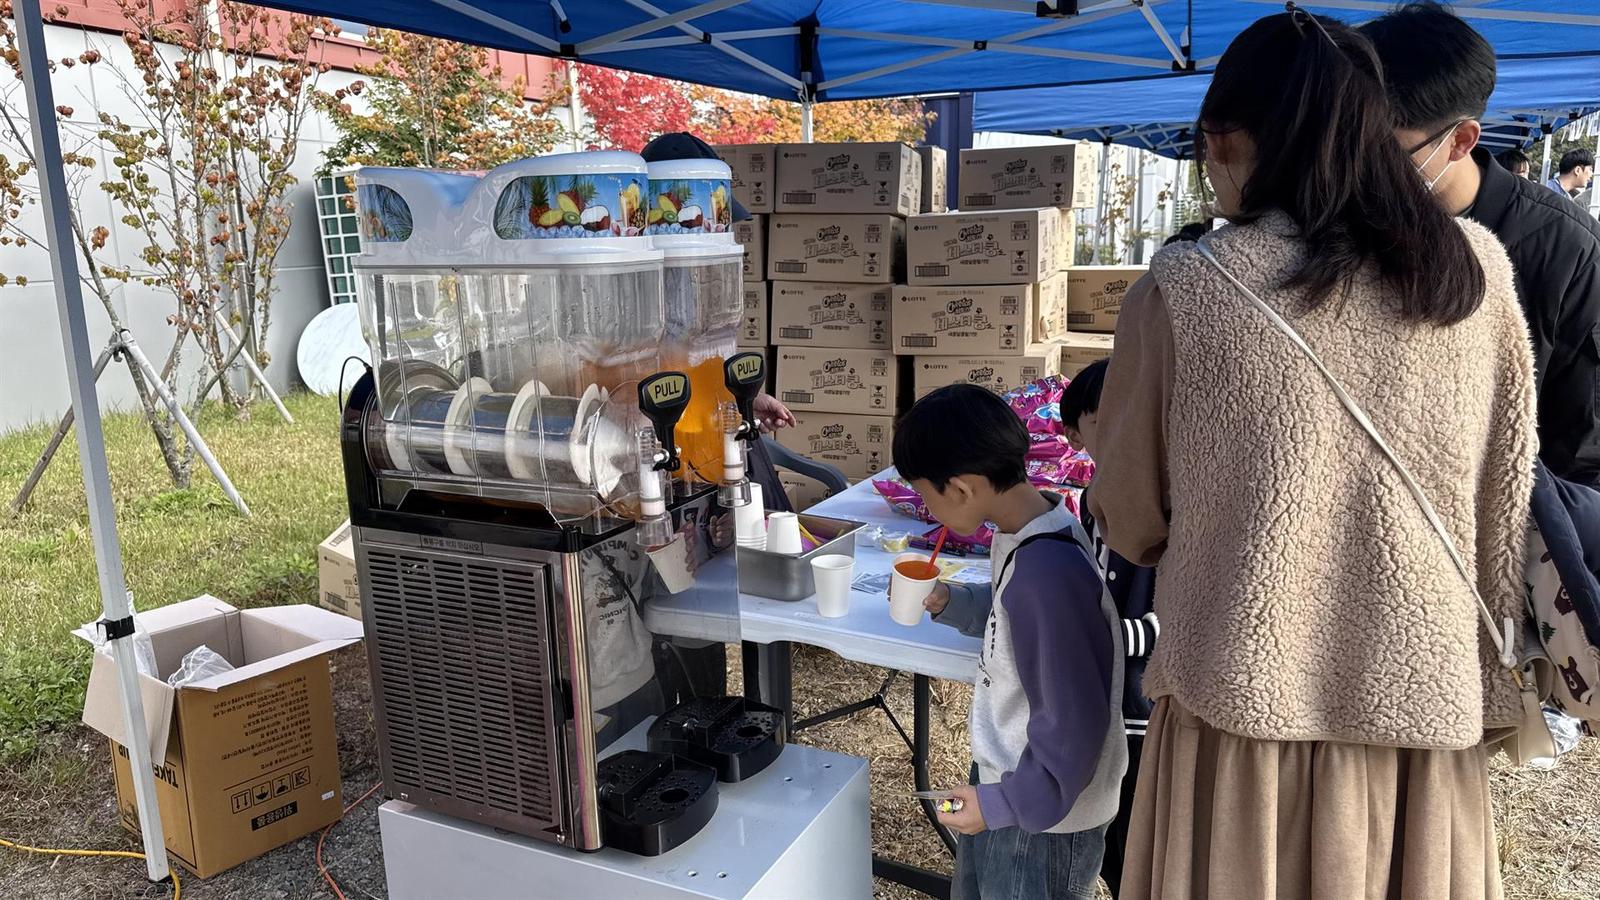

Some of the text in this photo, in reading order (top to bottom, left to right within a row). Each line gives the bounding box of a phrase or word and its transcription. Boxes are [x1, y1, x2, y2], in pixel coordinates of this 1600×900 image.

[737, 360, 758, 376] PULL
[654, 380, 680, 398] PULL
[256, 804, 293, 828] 위생용품
